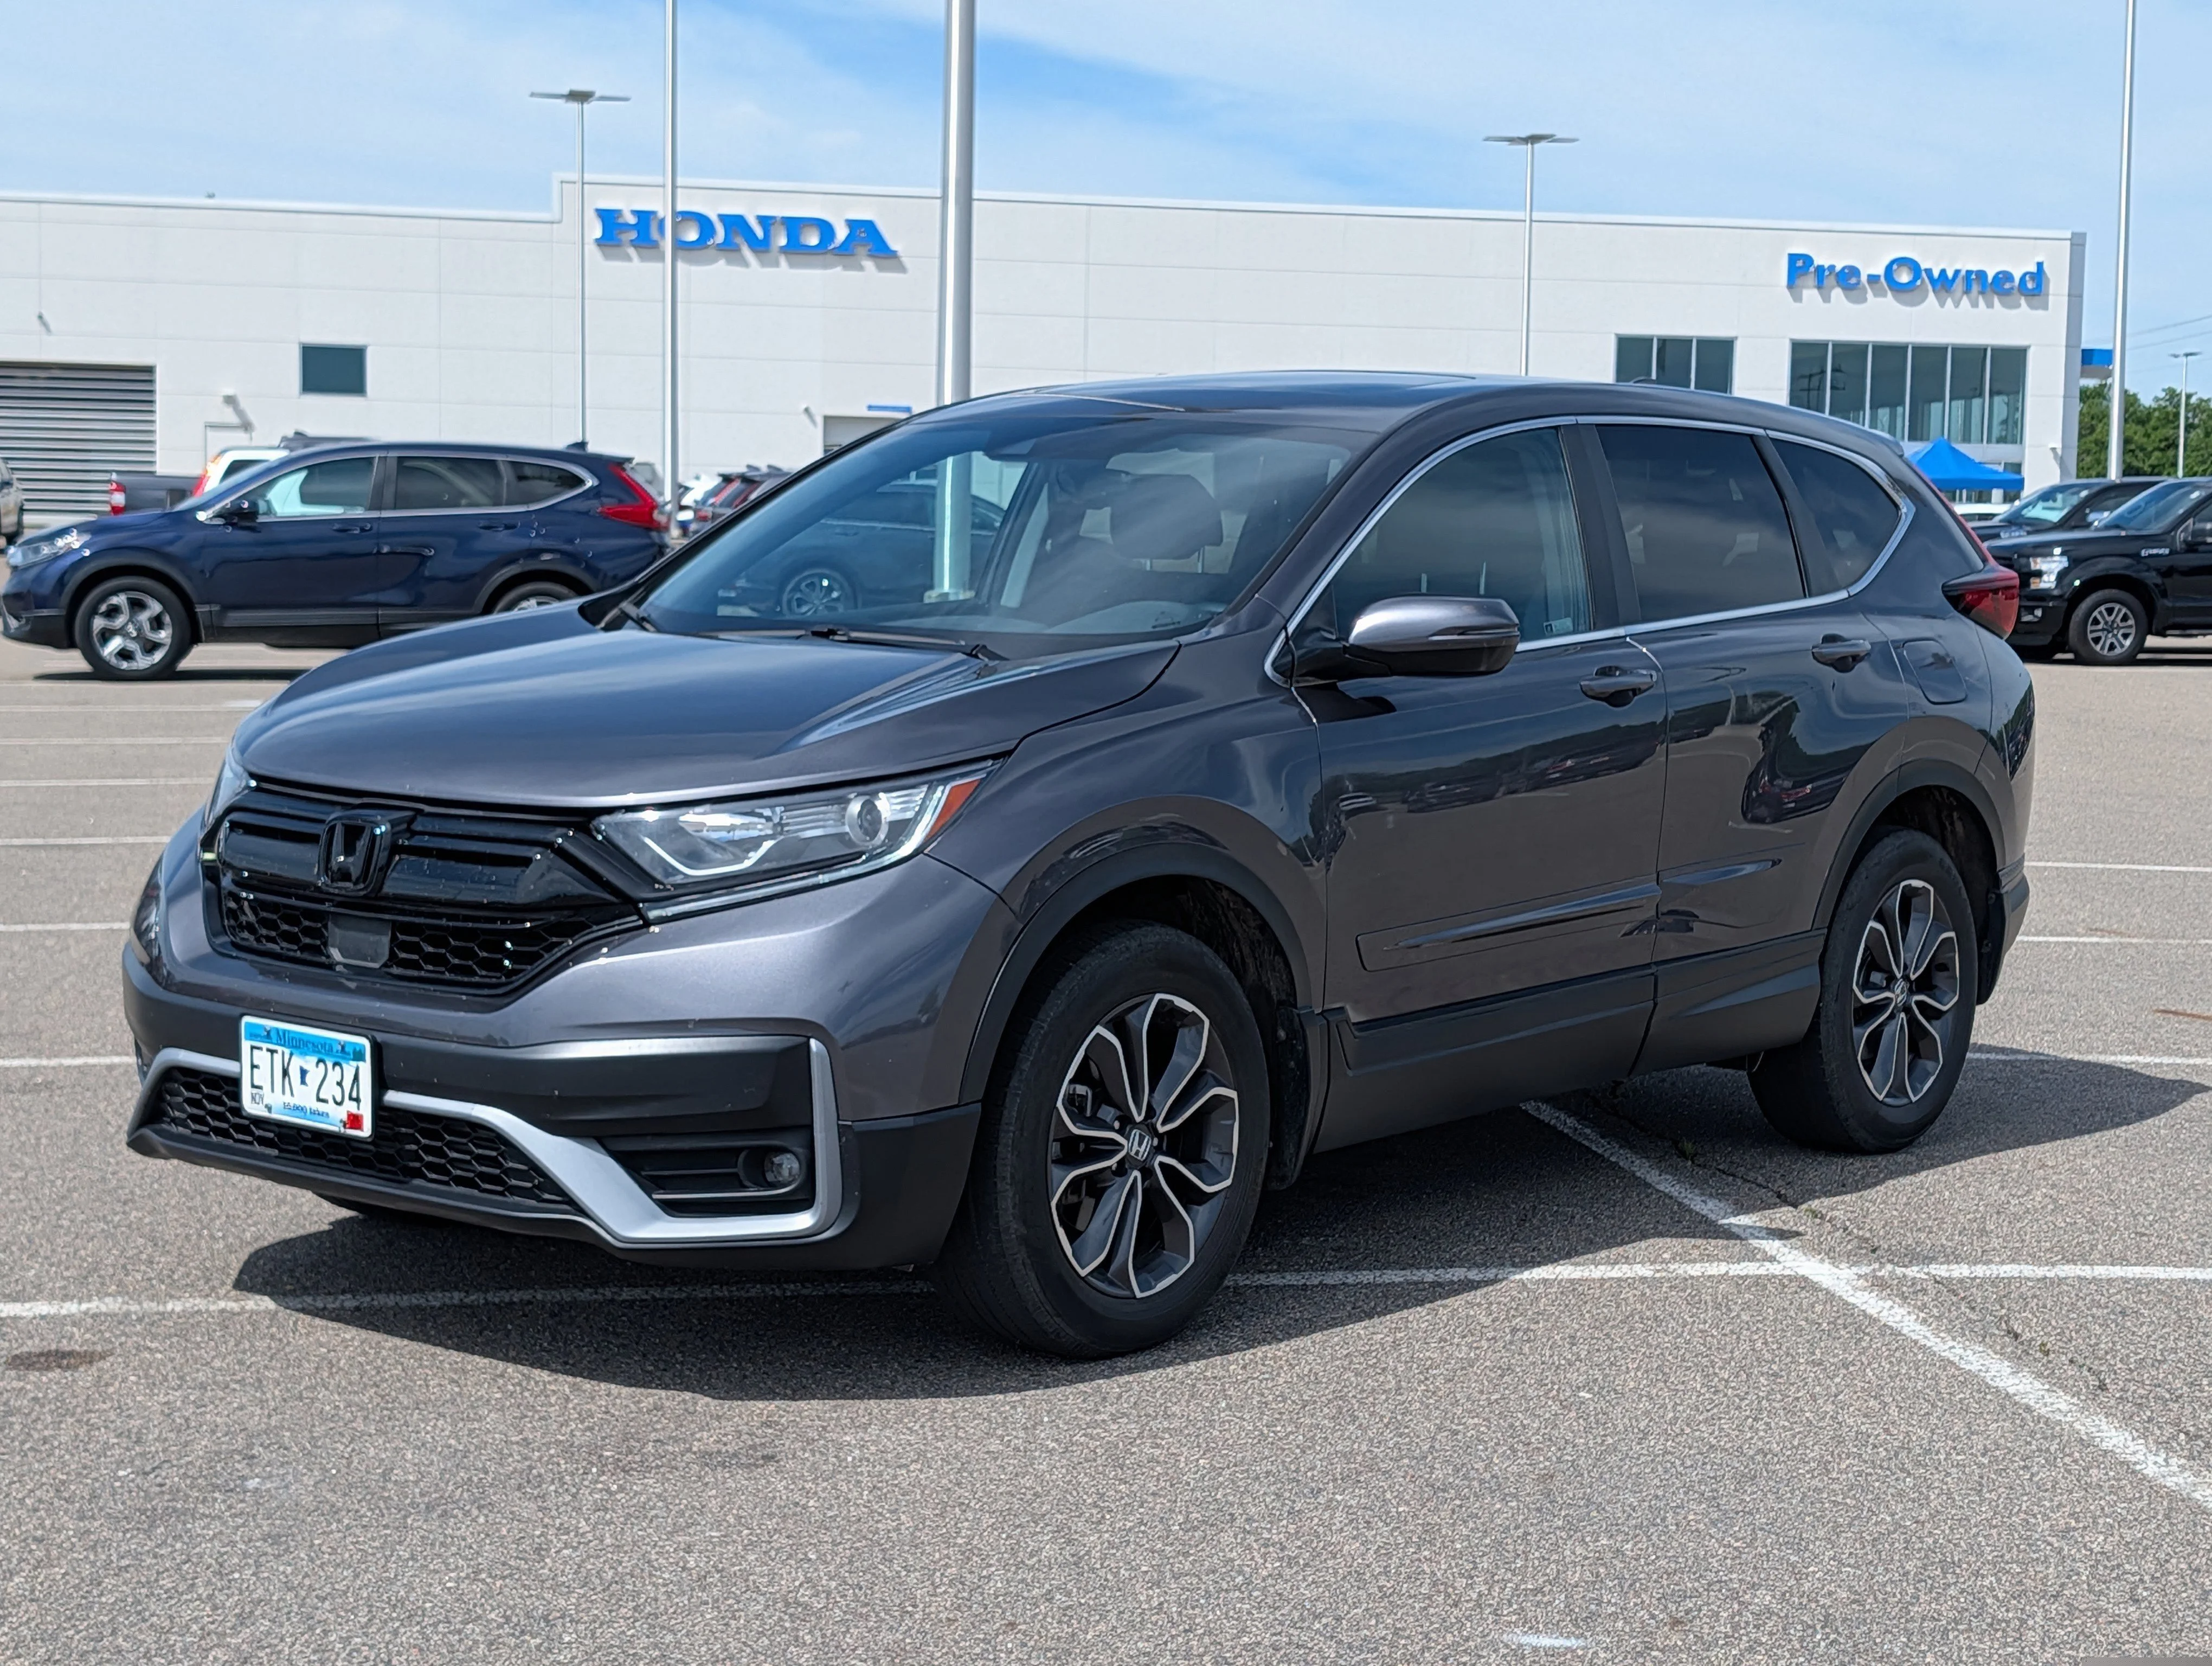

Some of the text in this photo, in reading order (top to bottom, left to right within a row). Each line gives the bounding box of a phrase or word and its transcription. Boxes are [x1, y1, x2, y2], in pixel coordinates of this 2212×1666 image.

[594, 208, 898, 256] HONDA
[1786, 253, 2044, 296] Pre-Owned
[276, 1028, 333, 1053] Minnesota
[250, 1045, 361, 1111] ETK 234
